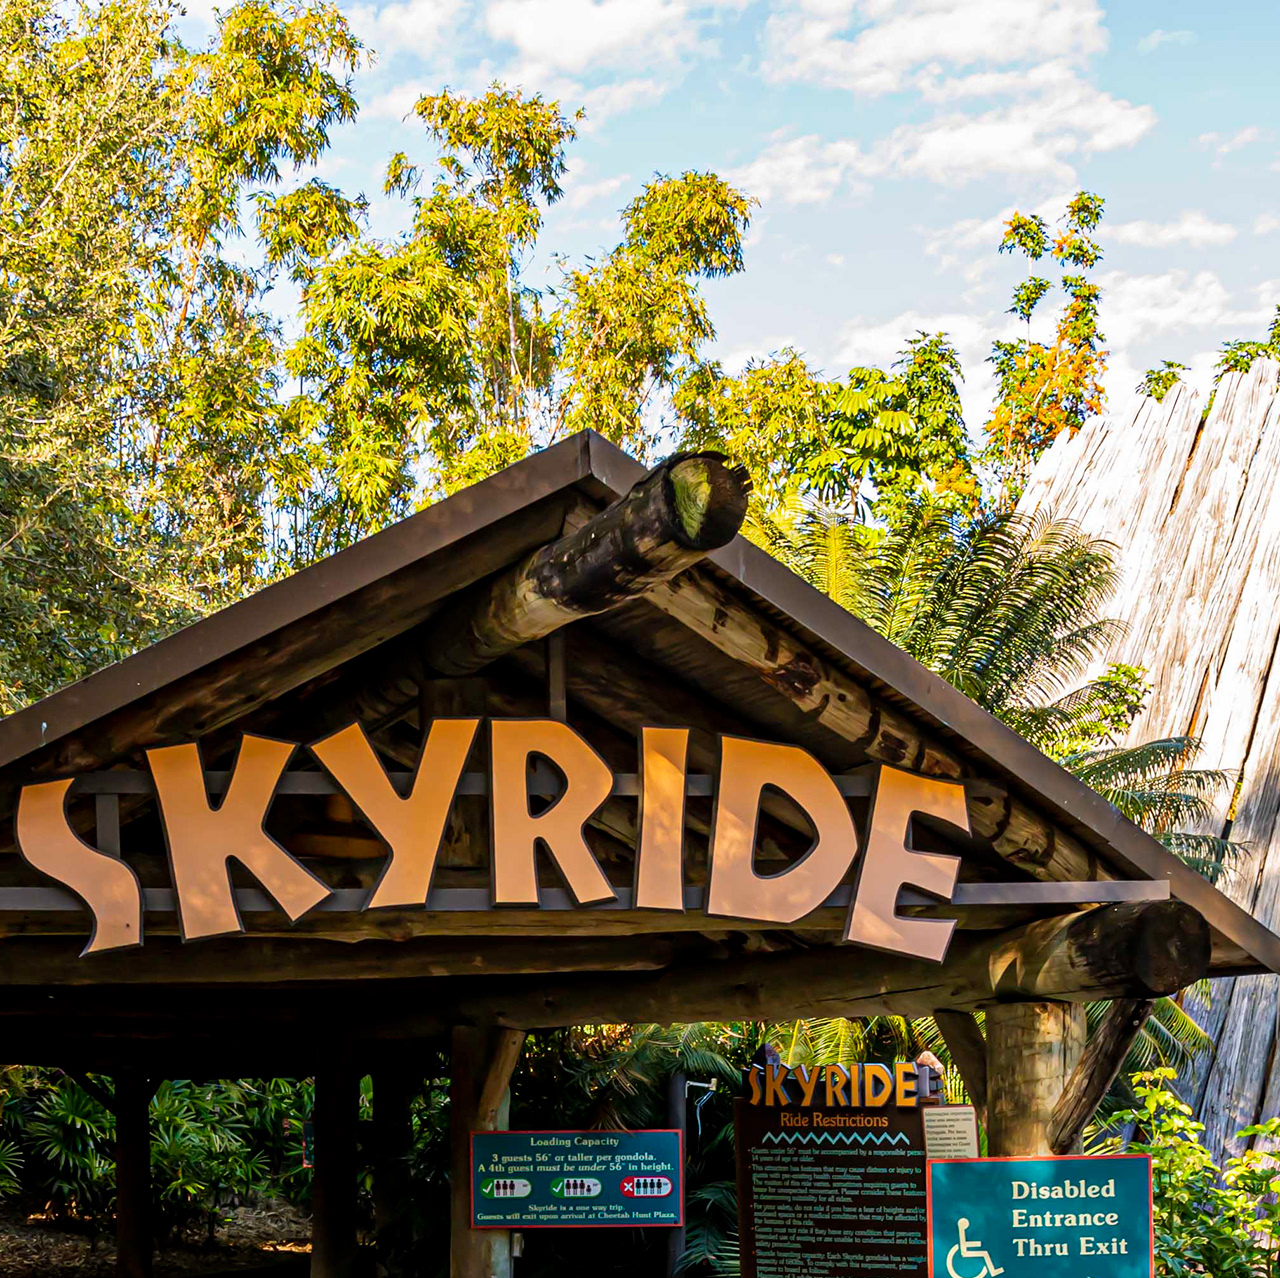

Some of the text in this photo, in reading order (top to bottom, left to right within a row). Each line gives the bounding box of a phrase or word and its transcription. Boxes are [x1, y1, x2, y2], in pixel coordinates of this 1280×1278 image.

[17, 716, 972, 963] SKYRIDE
[748, 1062, 919, 1107] SKYRIDE
[781, 1112, 888, 1127] Ride Restrictions
[530, 1137, 619, 1147] Loading Capacity
[492, 1153, 498, 1162] 3
[501, 1154, 532, 1163] guests
[568, 1153, 593, 1161] taller
[596, 1155, 612, 1163] per
[615, 1152, 656, 1162] gondola.
[478, 1163, 485, 1172] A
[489, 1163, 504, 1172] 4th
[508, 1164, 533, 1174] guest
[563, 1163, 575, 1171] be
[578, 1163, 606, 1171] under
[628, 1163, 637, 1171] in
[641, 1162, 674, 1172] height.
[1011, 1179, 1115, 1200] Disabled
[528, 1204, 557, 1212] Skyride
[1012, 1209, 1119, 1228] Entrance
[1013, 1237, 1128, 1257] Thru Exit
